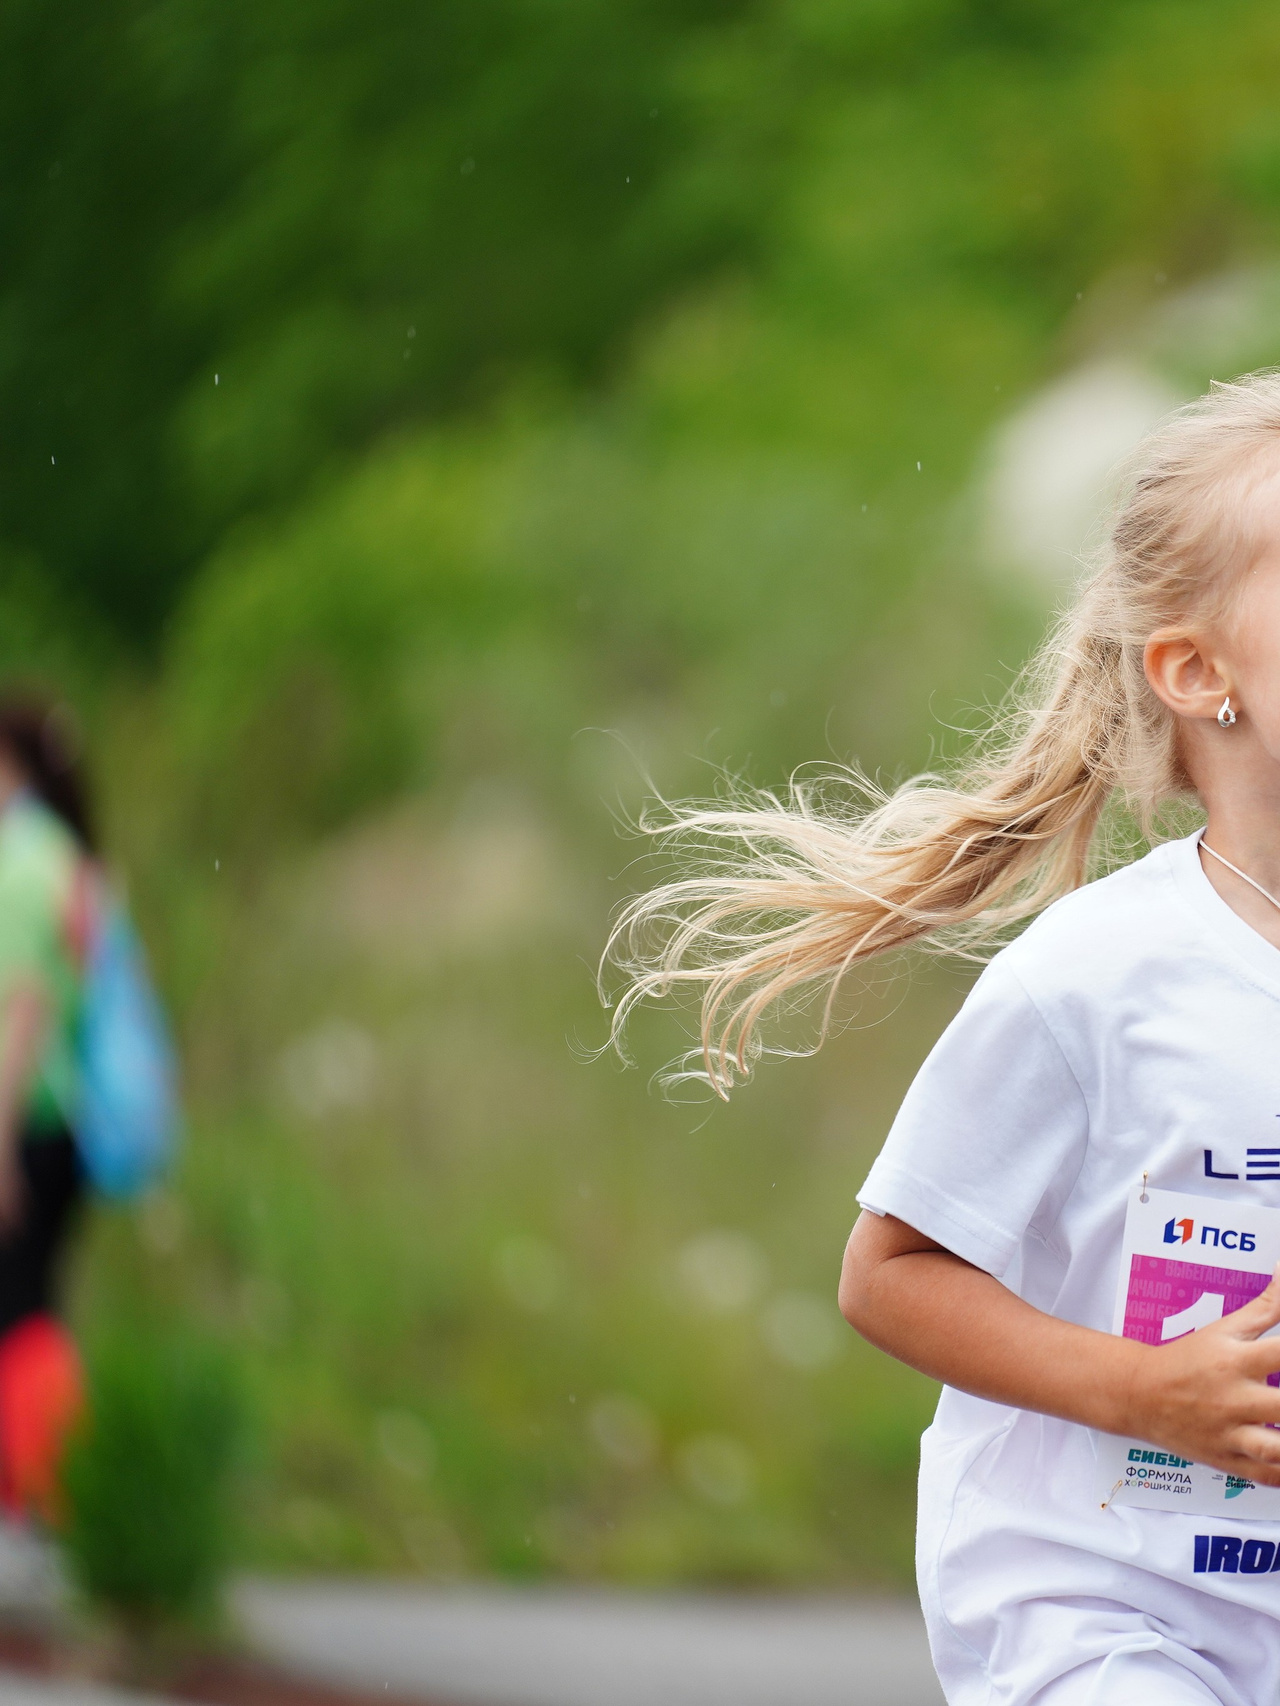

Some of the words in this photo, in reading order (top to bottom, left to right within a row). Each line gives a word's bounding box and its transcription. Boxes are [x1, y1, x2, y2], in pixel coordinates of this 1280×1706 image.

[1200, 1226, 1257, 1253] ПСБ
[1126, 1466, 1192, 1485] ФОРМУЛА
[1124, 1478, 1171, 1491] ХОРОШИХ
[1172, 1485, 1192, 1494] ДЕЛ
[1225, 1481, 1256, 1490] СИБИРЬ
